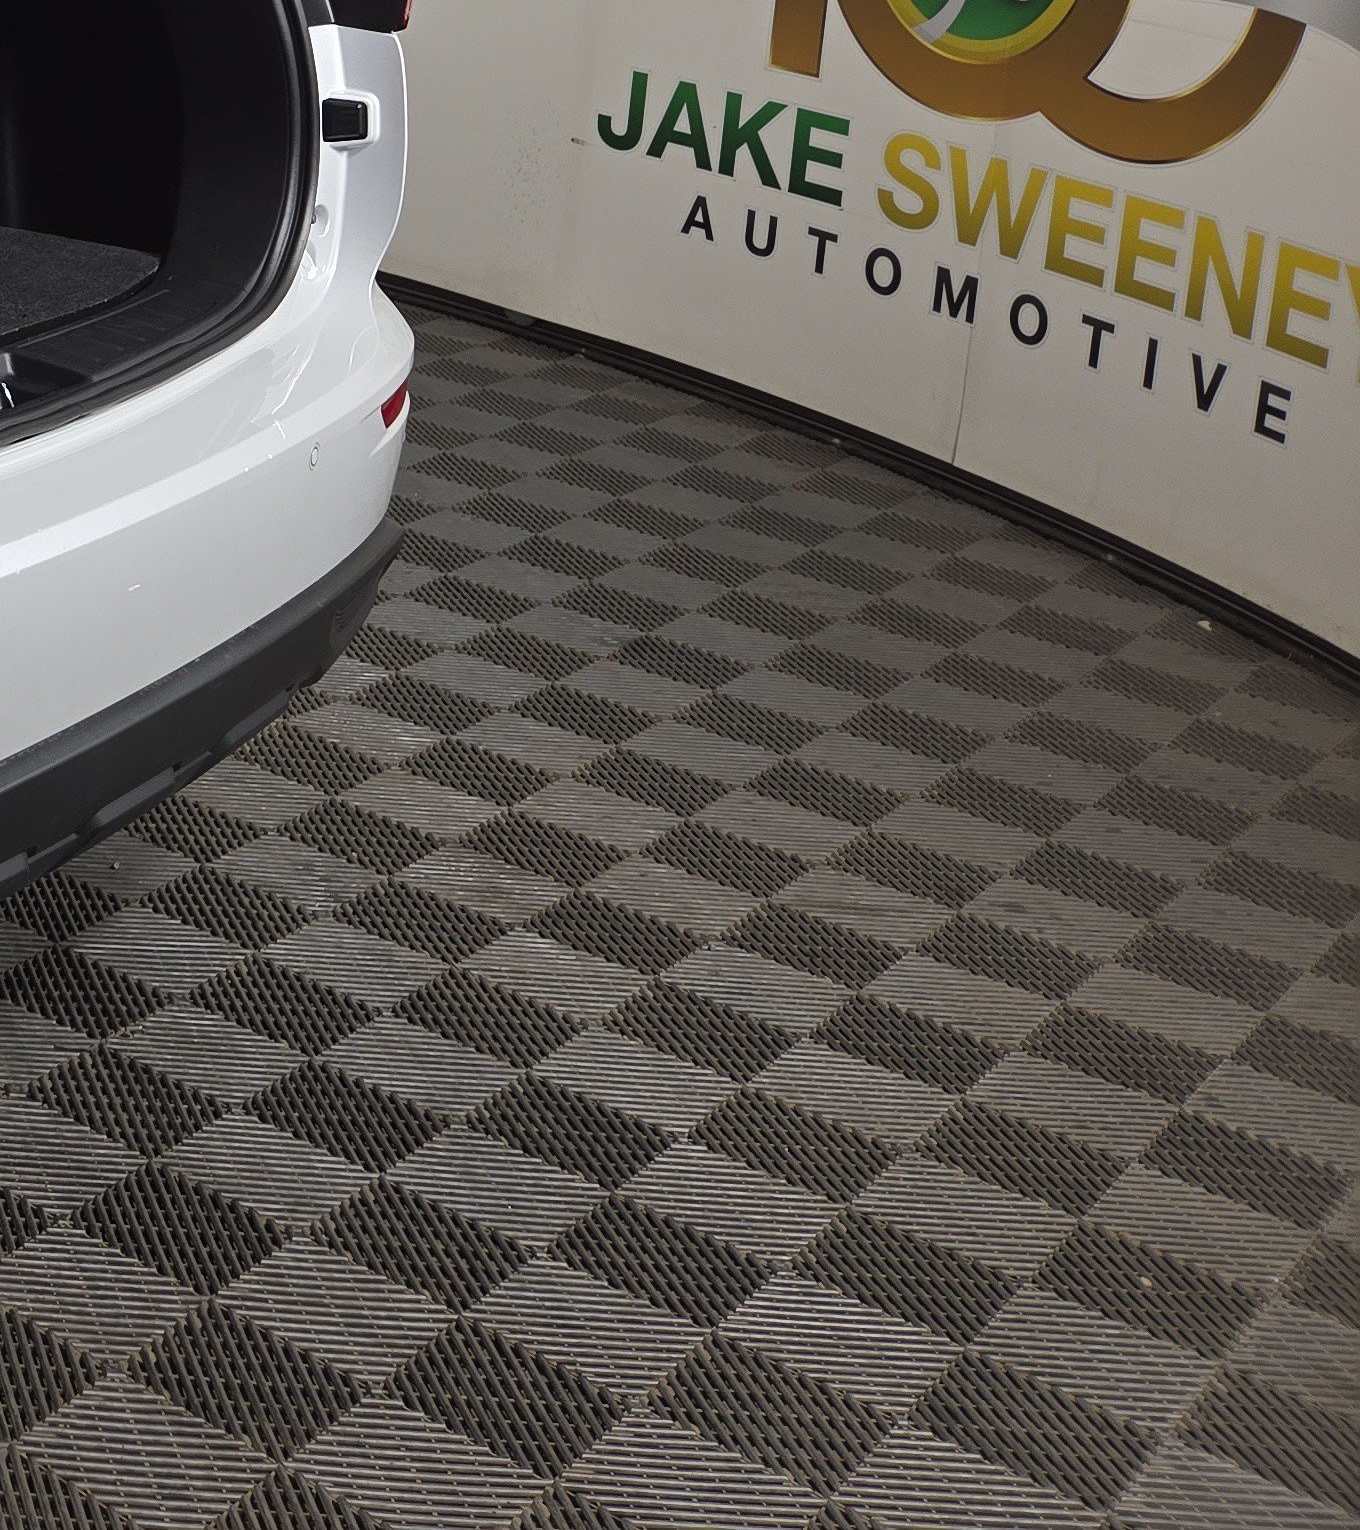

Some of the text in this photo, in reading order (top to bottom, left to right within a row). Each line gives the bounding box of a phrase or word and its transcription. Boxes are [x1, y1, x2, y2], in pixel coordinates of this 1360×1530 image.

[596, 70, 1360, 384] JAKE SWEENE
[680, 195, 1293, 445] AUTOMOTIVE
